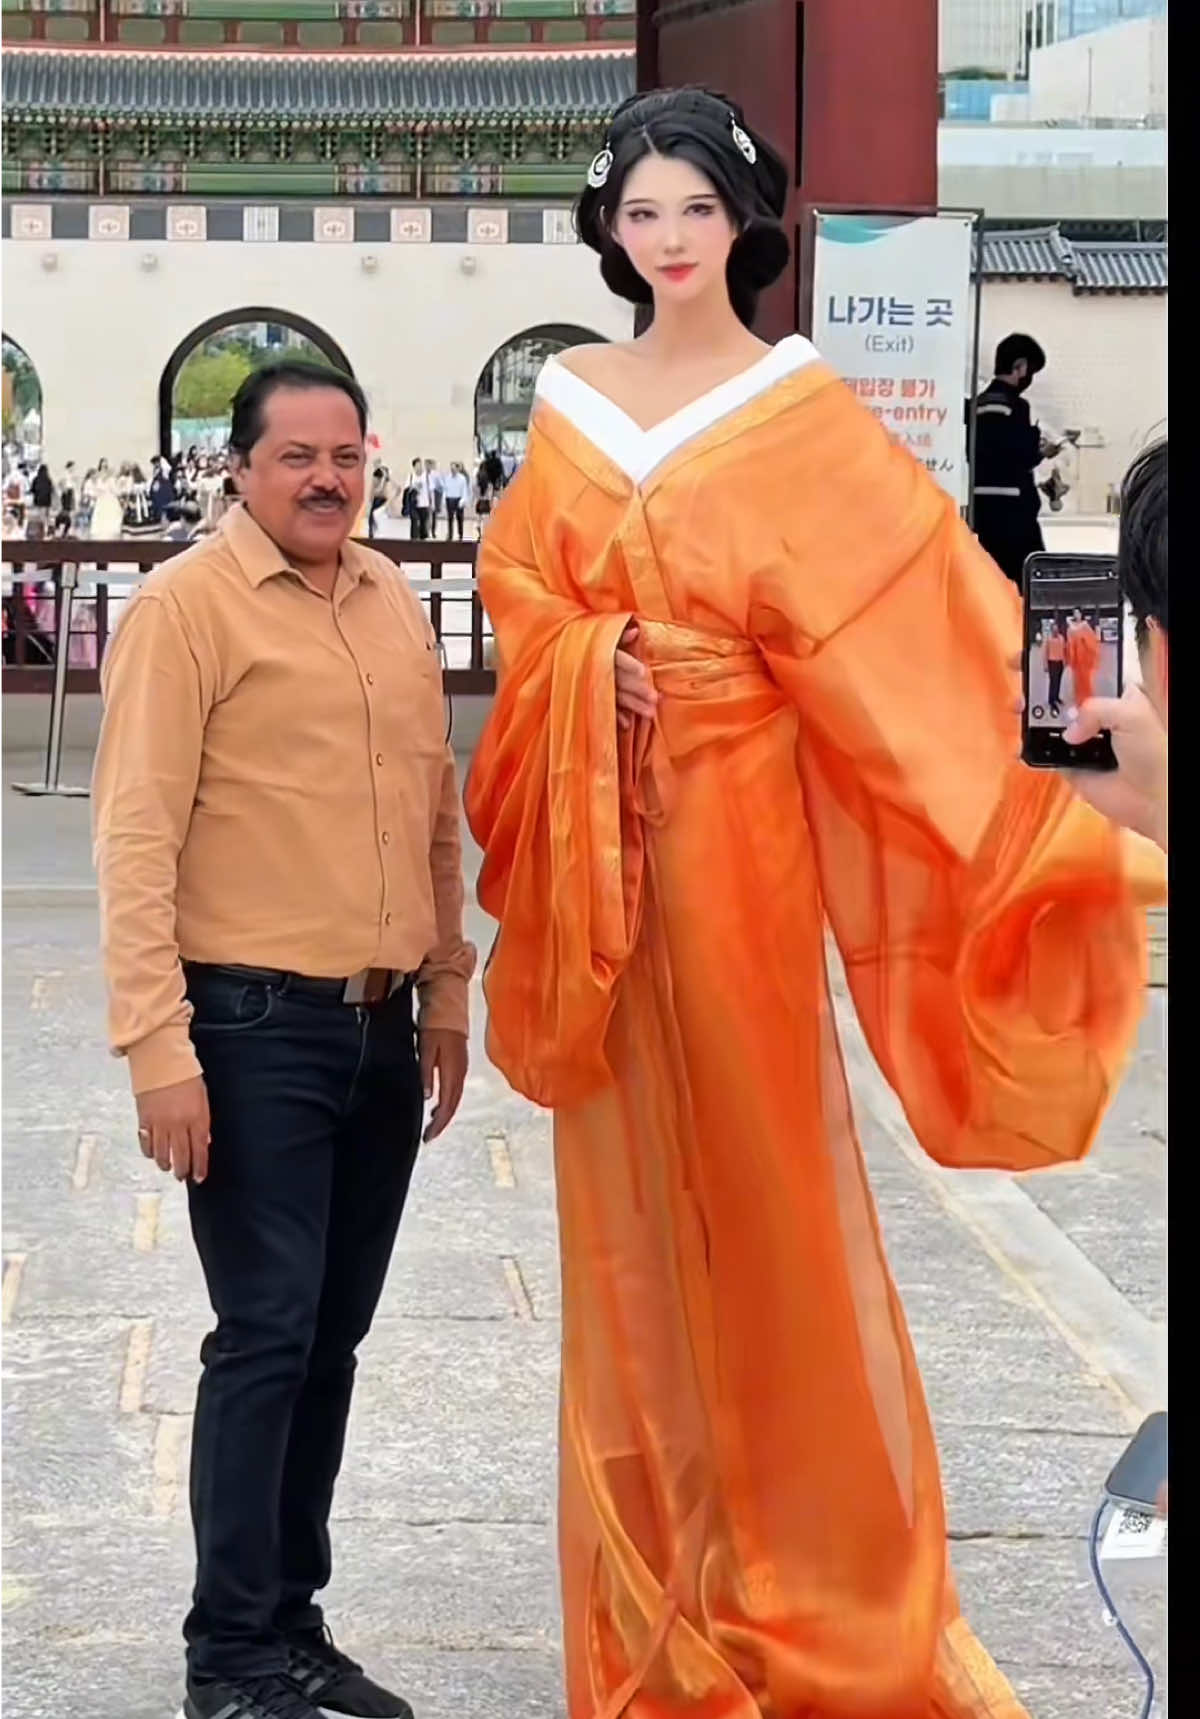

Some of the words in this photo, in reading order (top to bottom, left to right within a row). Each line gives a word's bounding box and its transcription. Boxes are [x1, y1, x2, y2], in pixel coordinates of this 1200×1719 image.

[828, 296, 915, 326] 나가는
[925, 298, 953, 327] 곳
[865, 335, 914, 353] (Exit)
[867, 404, 948, 426] e-entry
